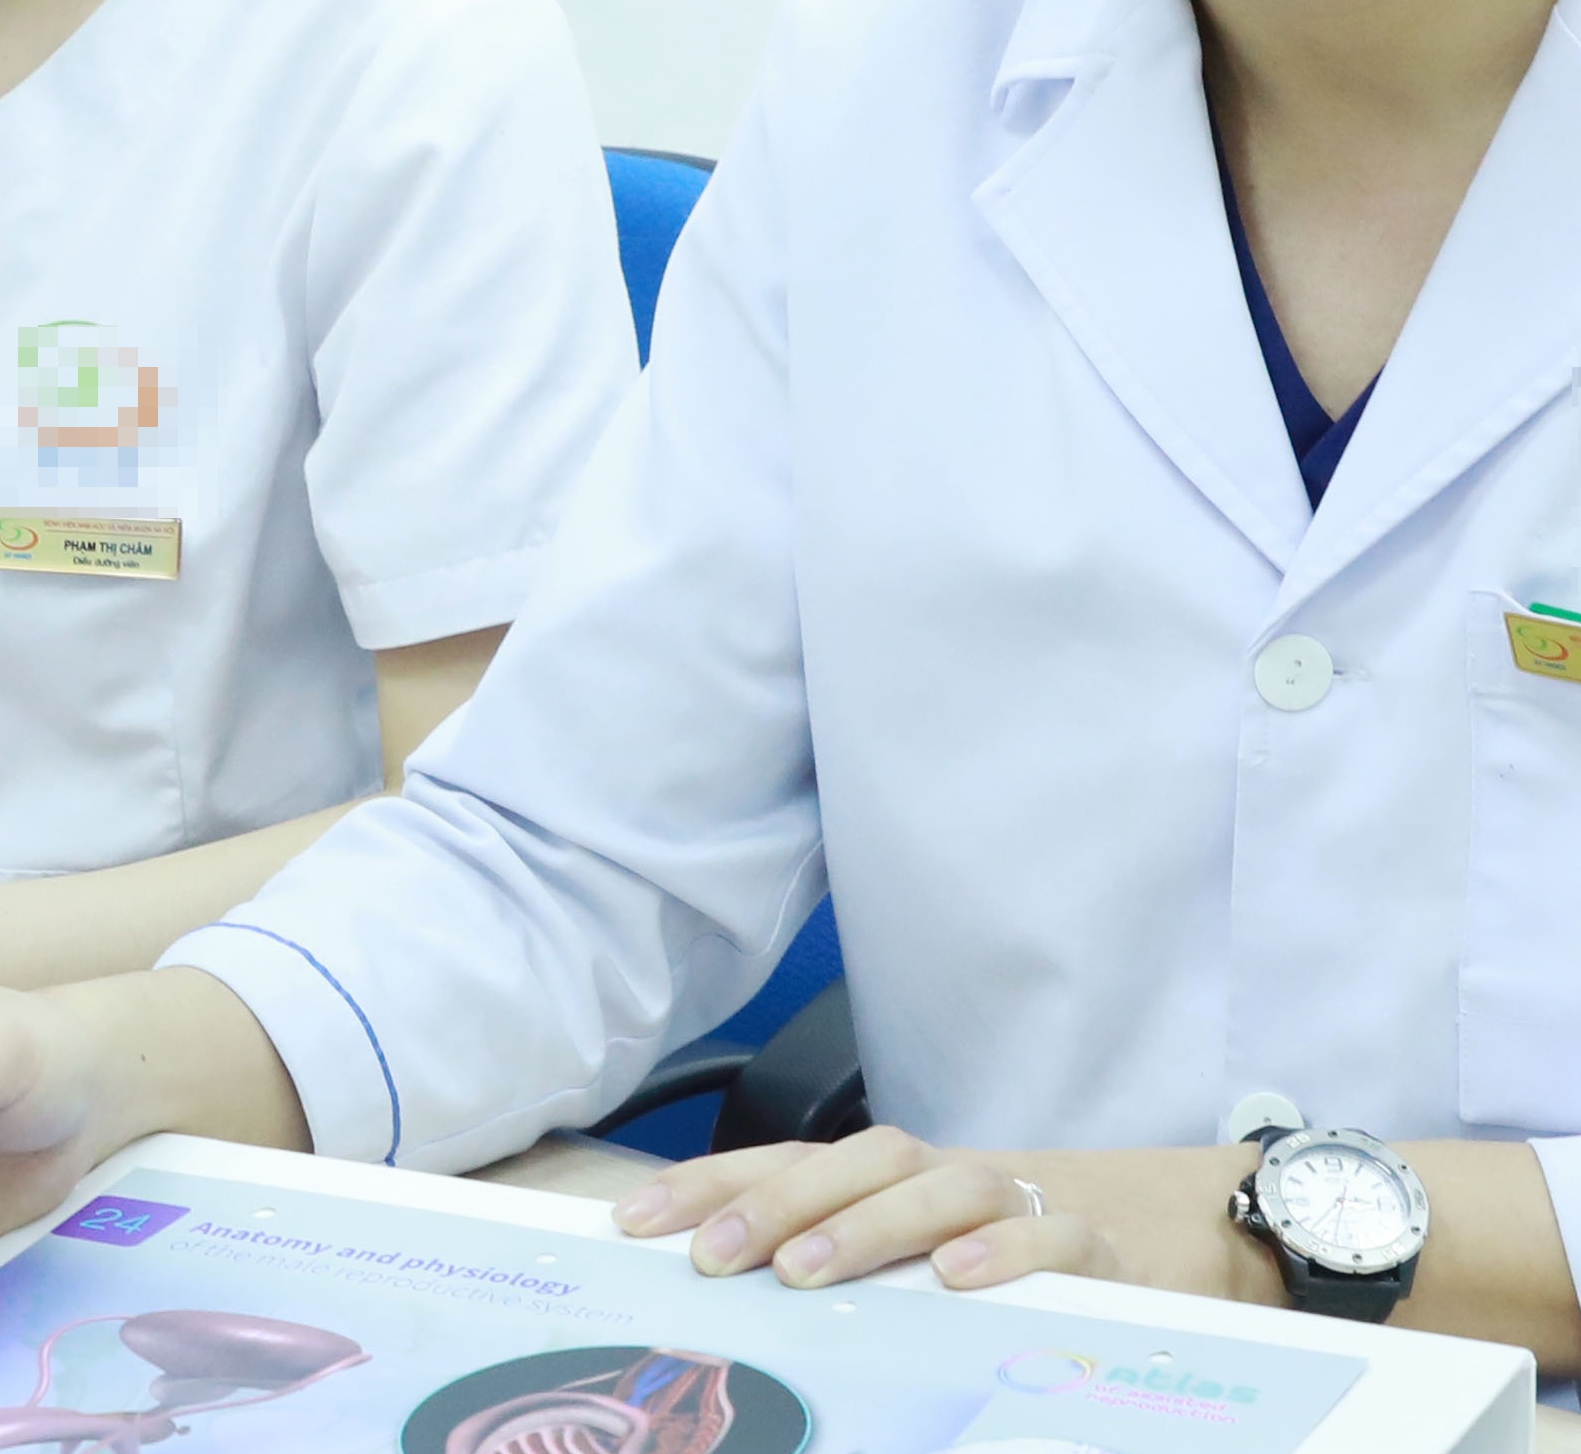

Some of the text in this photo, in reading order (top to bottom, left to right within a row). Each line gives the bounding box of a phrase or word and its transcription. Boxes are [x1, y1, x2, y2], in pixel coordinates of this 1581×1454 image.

[64, 540, 96, 555] PHẠM
[100, 542, 117, 557] THỊ
[79, 1207, 151, 1234] 24
[188, 1221, 582, 1297] Anatomy and physiology
[169, 1239, 635, 1325] of the male reproductive system
[1085, 1392, 1239, 1425] reproduction
[1125, 1389, 1229, 1412] assisted
